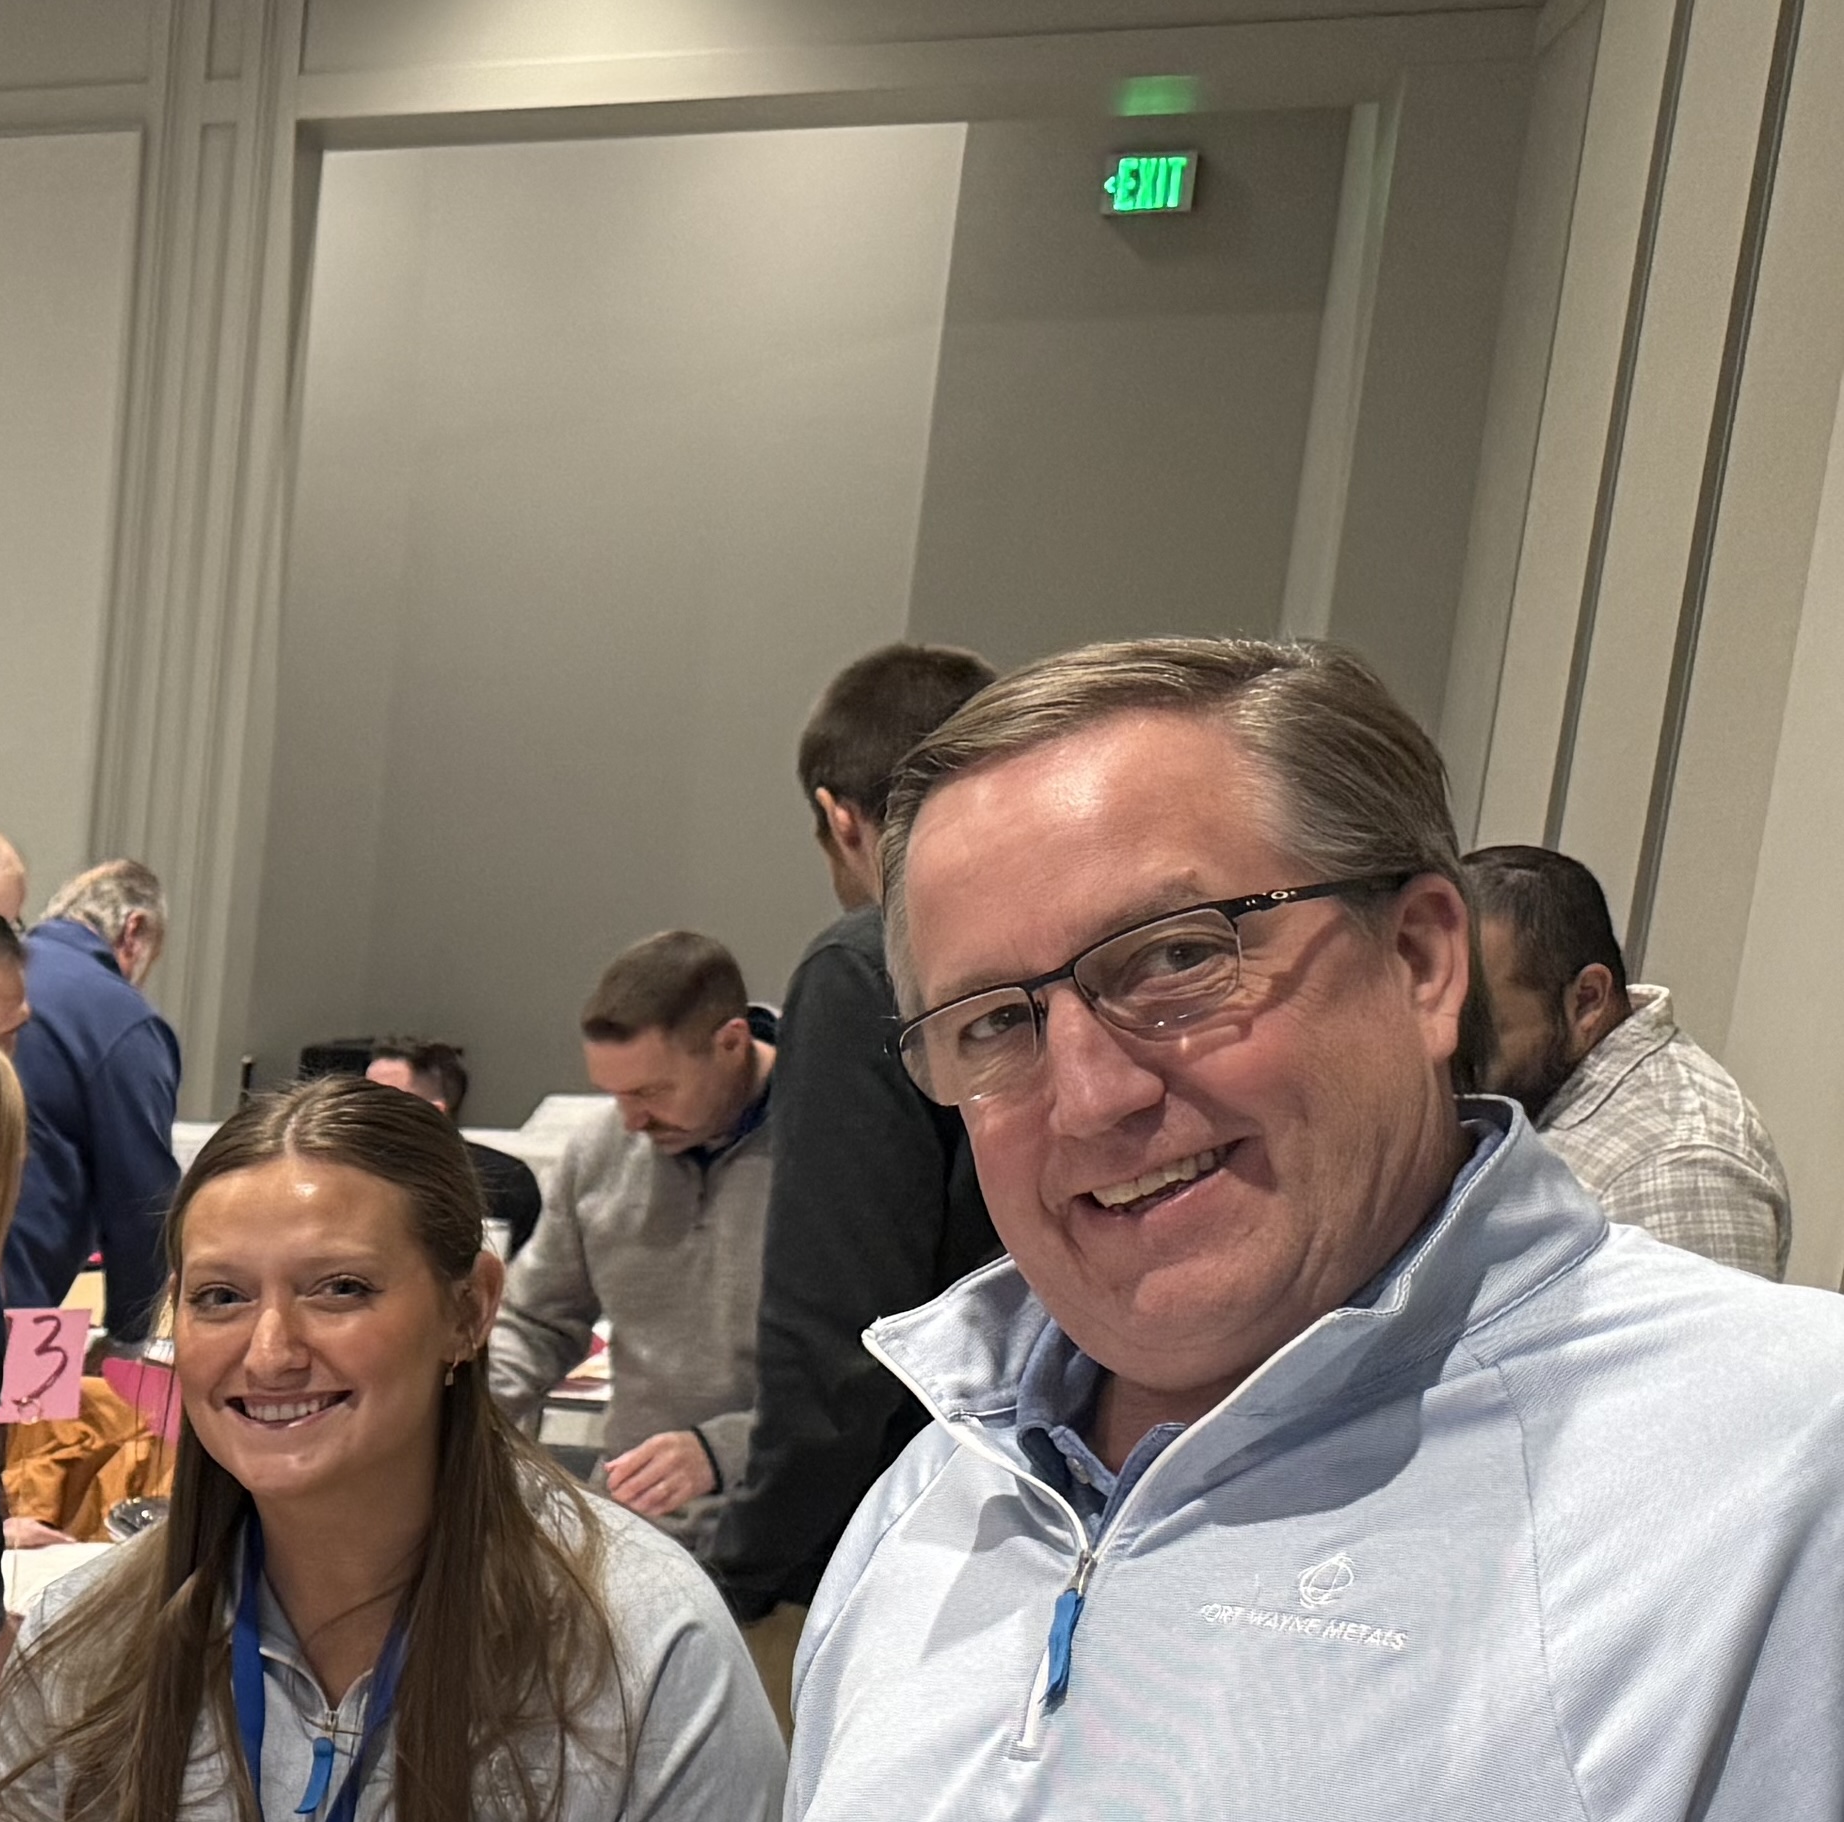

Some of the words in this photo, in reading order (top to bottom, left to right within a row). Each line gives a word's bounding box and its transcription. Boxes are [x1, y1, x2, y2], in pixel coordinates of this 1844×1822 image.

[1114, 157, 1187, 211] EXIT
[5, 1314, 69, 1406] 3
[1323, 1619, 1408, 1650] METALS
